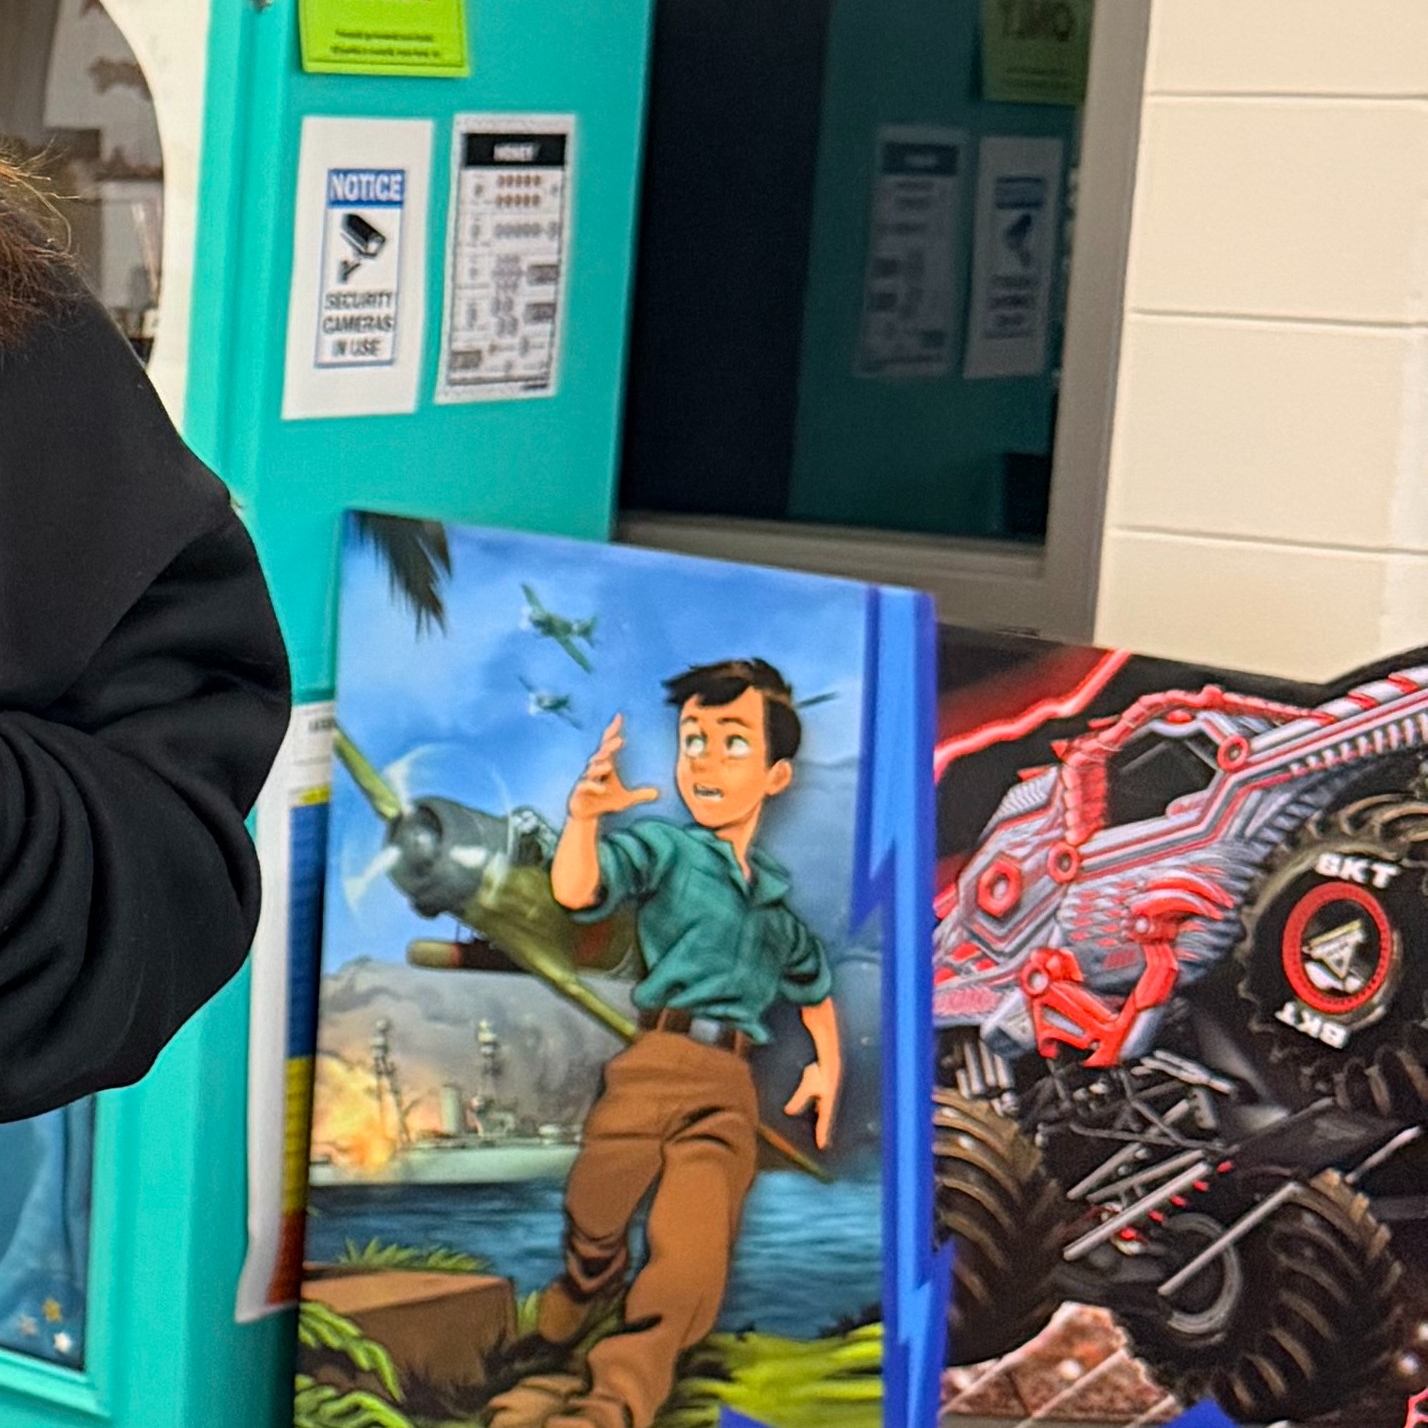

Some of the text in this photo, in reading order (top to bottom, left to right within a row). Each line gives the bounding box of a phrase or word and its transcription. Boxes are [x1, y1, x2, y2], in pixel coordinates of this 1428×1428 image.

[330, 174, 401, 202] NOTICE
[325, 291, 392, 309] SECURITY
[323, 314, 394, 334] CAMERAS
[332, 338, 380, 356] IN USE
[1314, 852, 1400, 889] BKT
